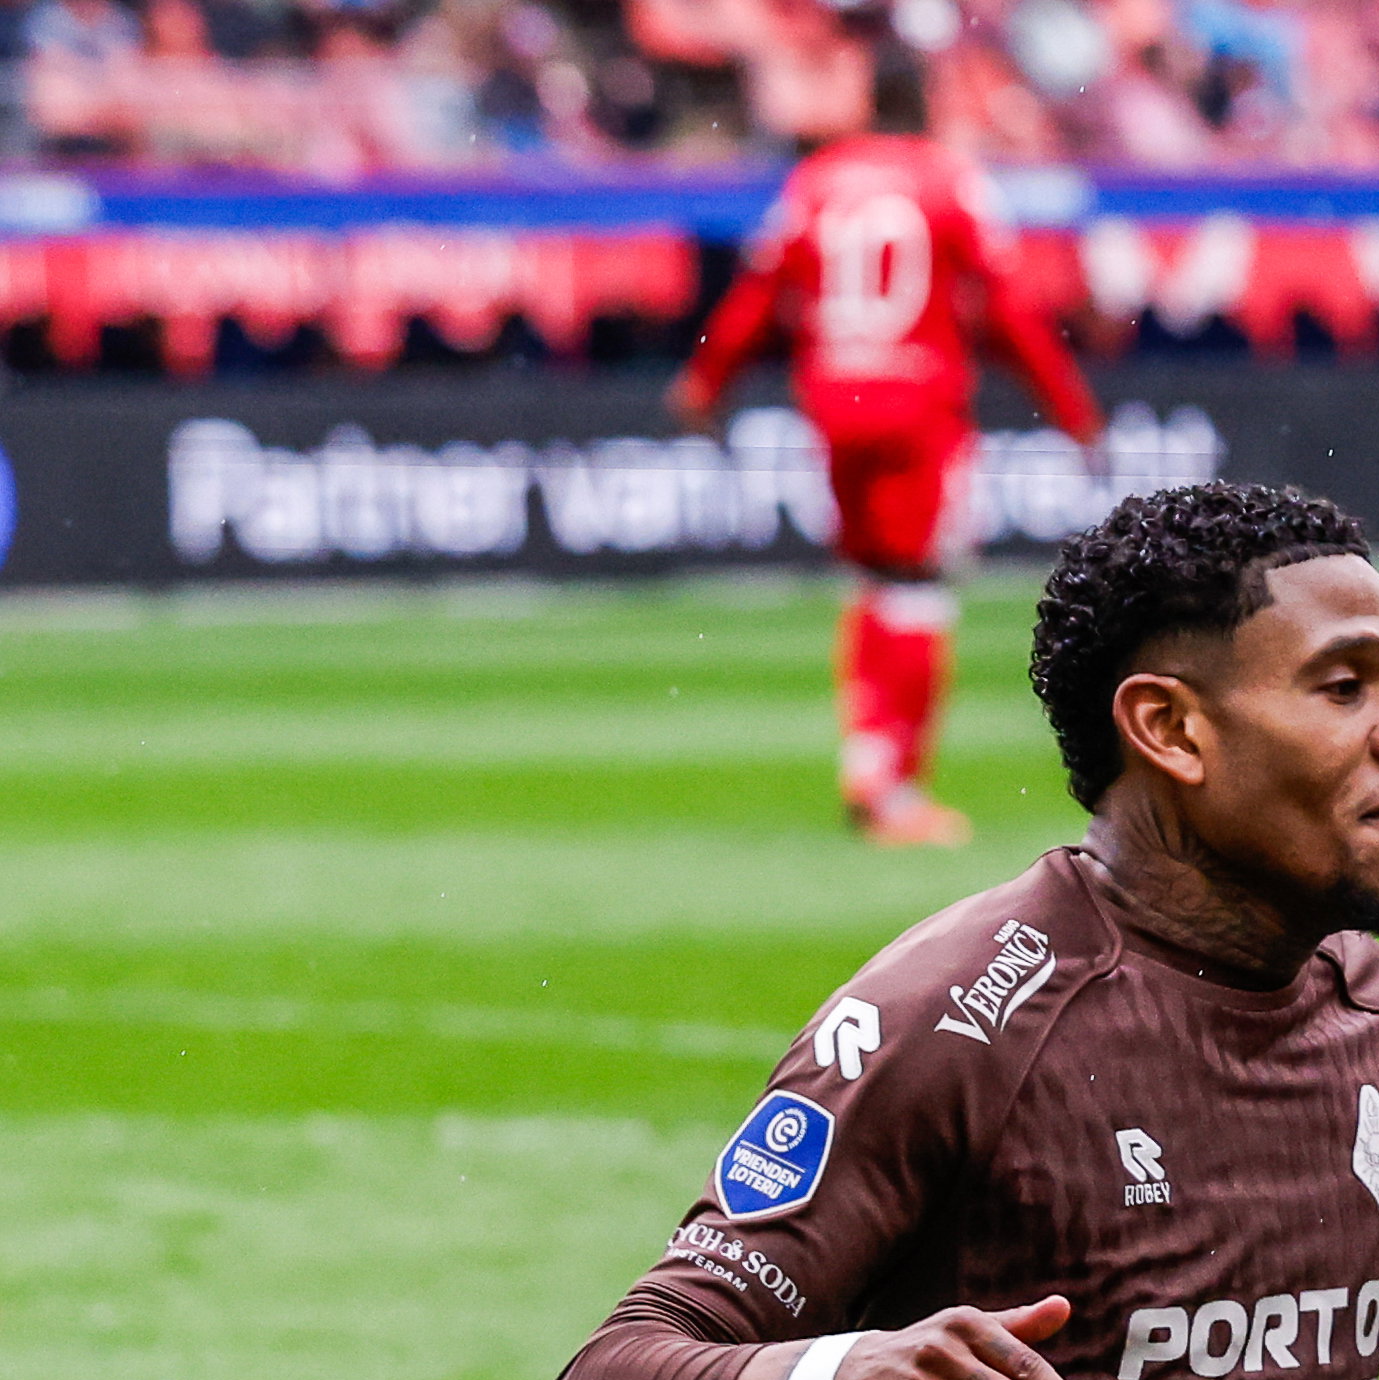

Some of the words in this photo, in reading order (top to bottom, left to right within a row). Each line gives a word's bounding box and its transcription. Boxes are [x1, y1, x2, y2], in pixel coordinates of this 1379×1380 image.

[818, 193, 935, 338] 10
[933, 924, 1049, 1045] VERONICA
[732, 1146, 802, 1189] VRIENDEN
[1124, 1181, 1170, 1207] ROBEY
[741, 1250, 807, 1319] SODA
